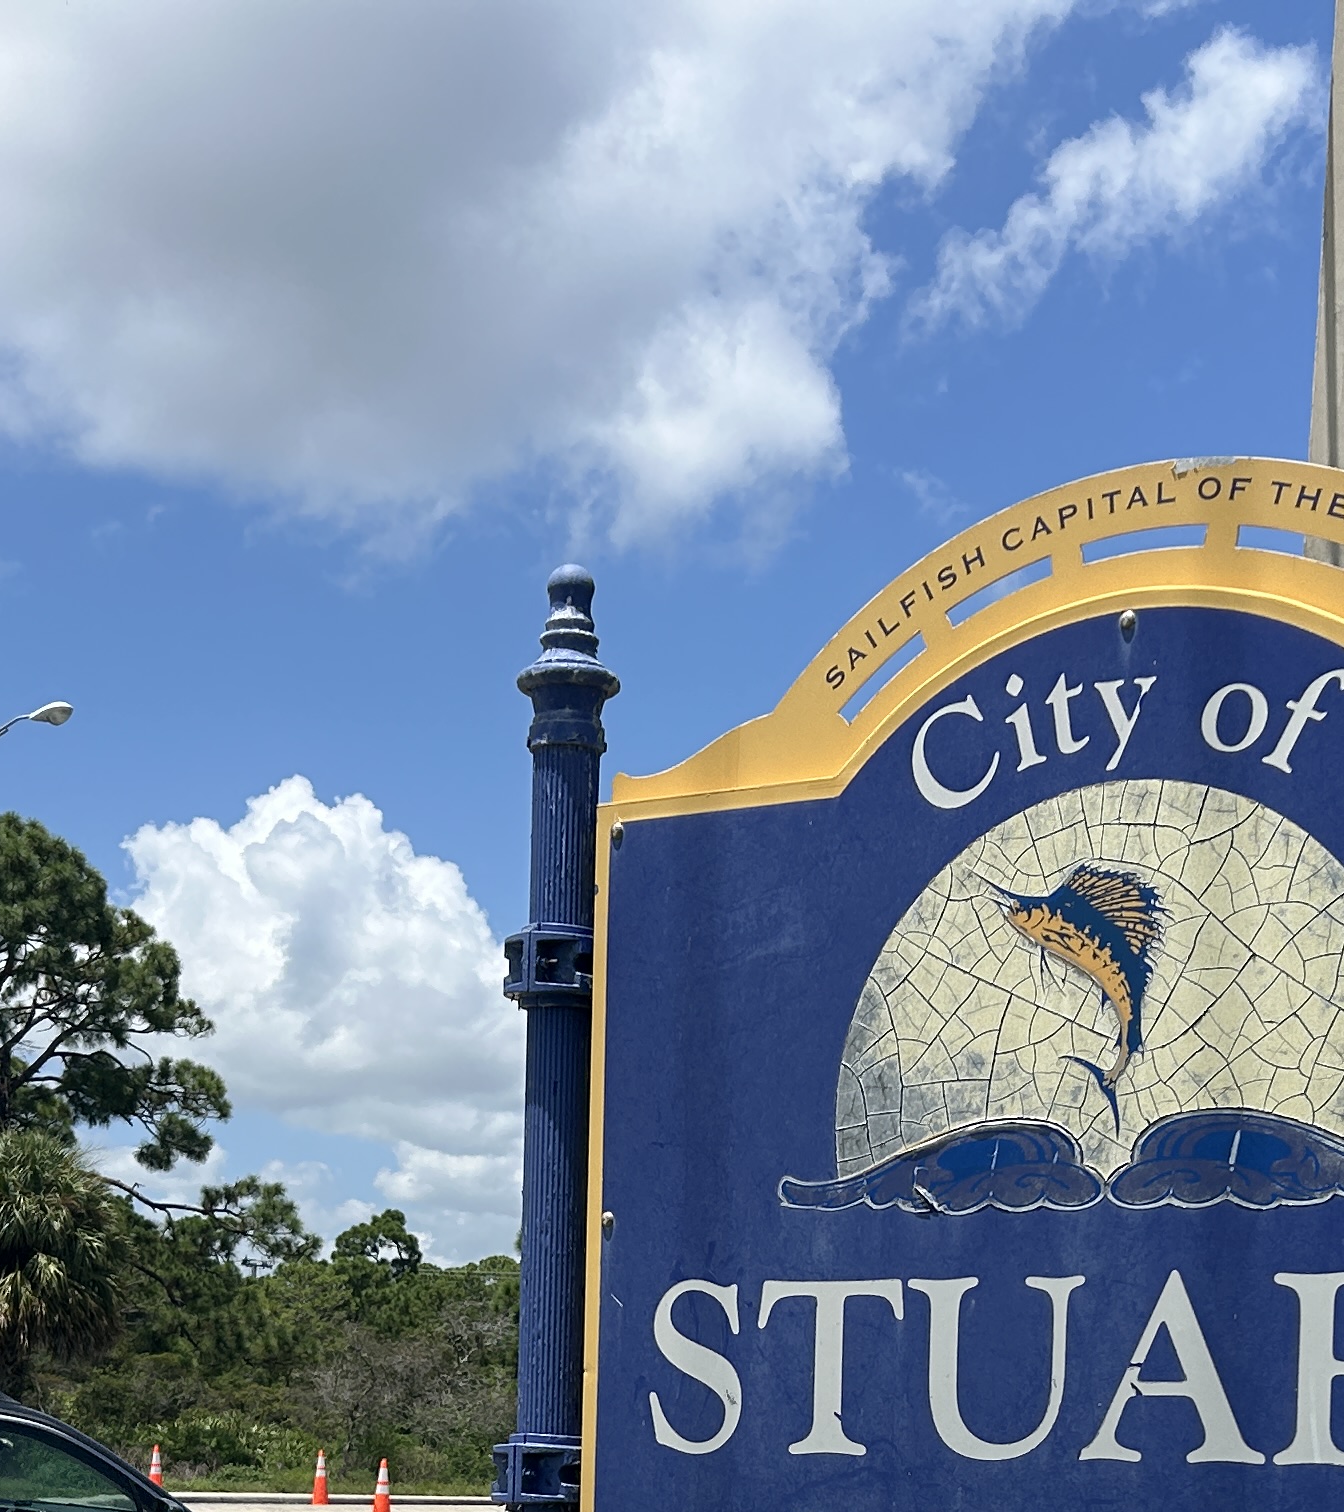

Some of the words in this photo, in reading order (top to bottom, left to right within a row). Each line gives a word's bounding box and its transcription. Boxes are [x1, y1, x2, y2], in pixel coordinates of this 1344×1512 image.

[826, 545, 987, 690] SAILFISH
[1002, 482, 1177, 552] CAPITAL
[1198, 476, 1253, 502] OF
[911, 672, 1158, 809] City
